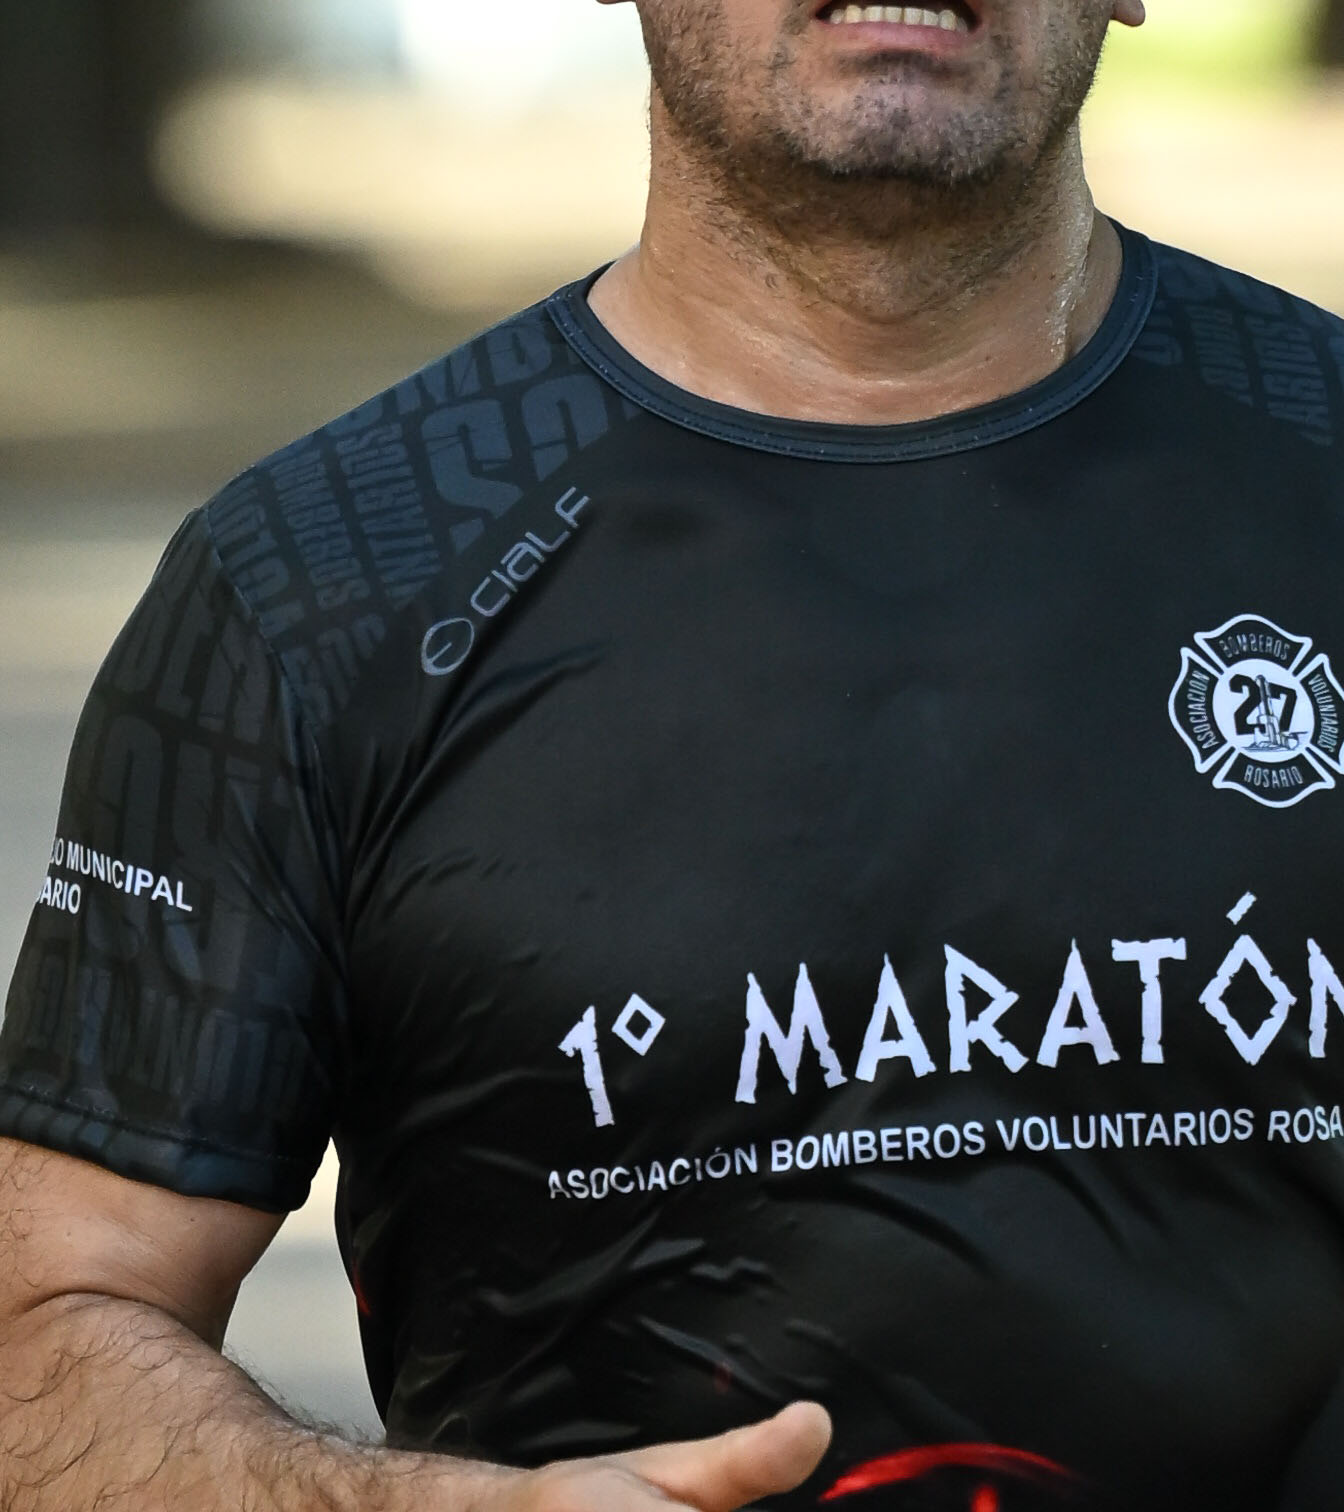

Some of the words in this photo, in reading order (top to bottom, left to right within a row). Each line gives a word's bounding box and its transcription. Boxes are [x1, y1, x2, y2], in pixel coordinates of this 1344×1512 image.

[1228, 673, 1298, 736] 27
[1307, 673, 1339, 753] VOLUNTARIOS
[1243, 764, 1304, 789] ROSARIO
[37, 875, 82, 916] ARIO
[66, 840, 193, 912] MUNICIPAL
[548, 1144, 758, 1200] ASOCIACIÓN
[770, 1120, 986, 1172] BOMBEROS
[996, 1108, 1255, 1152] VOLUNTARIOS
